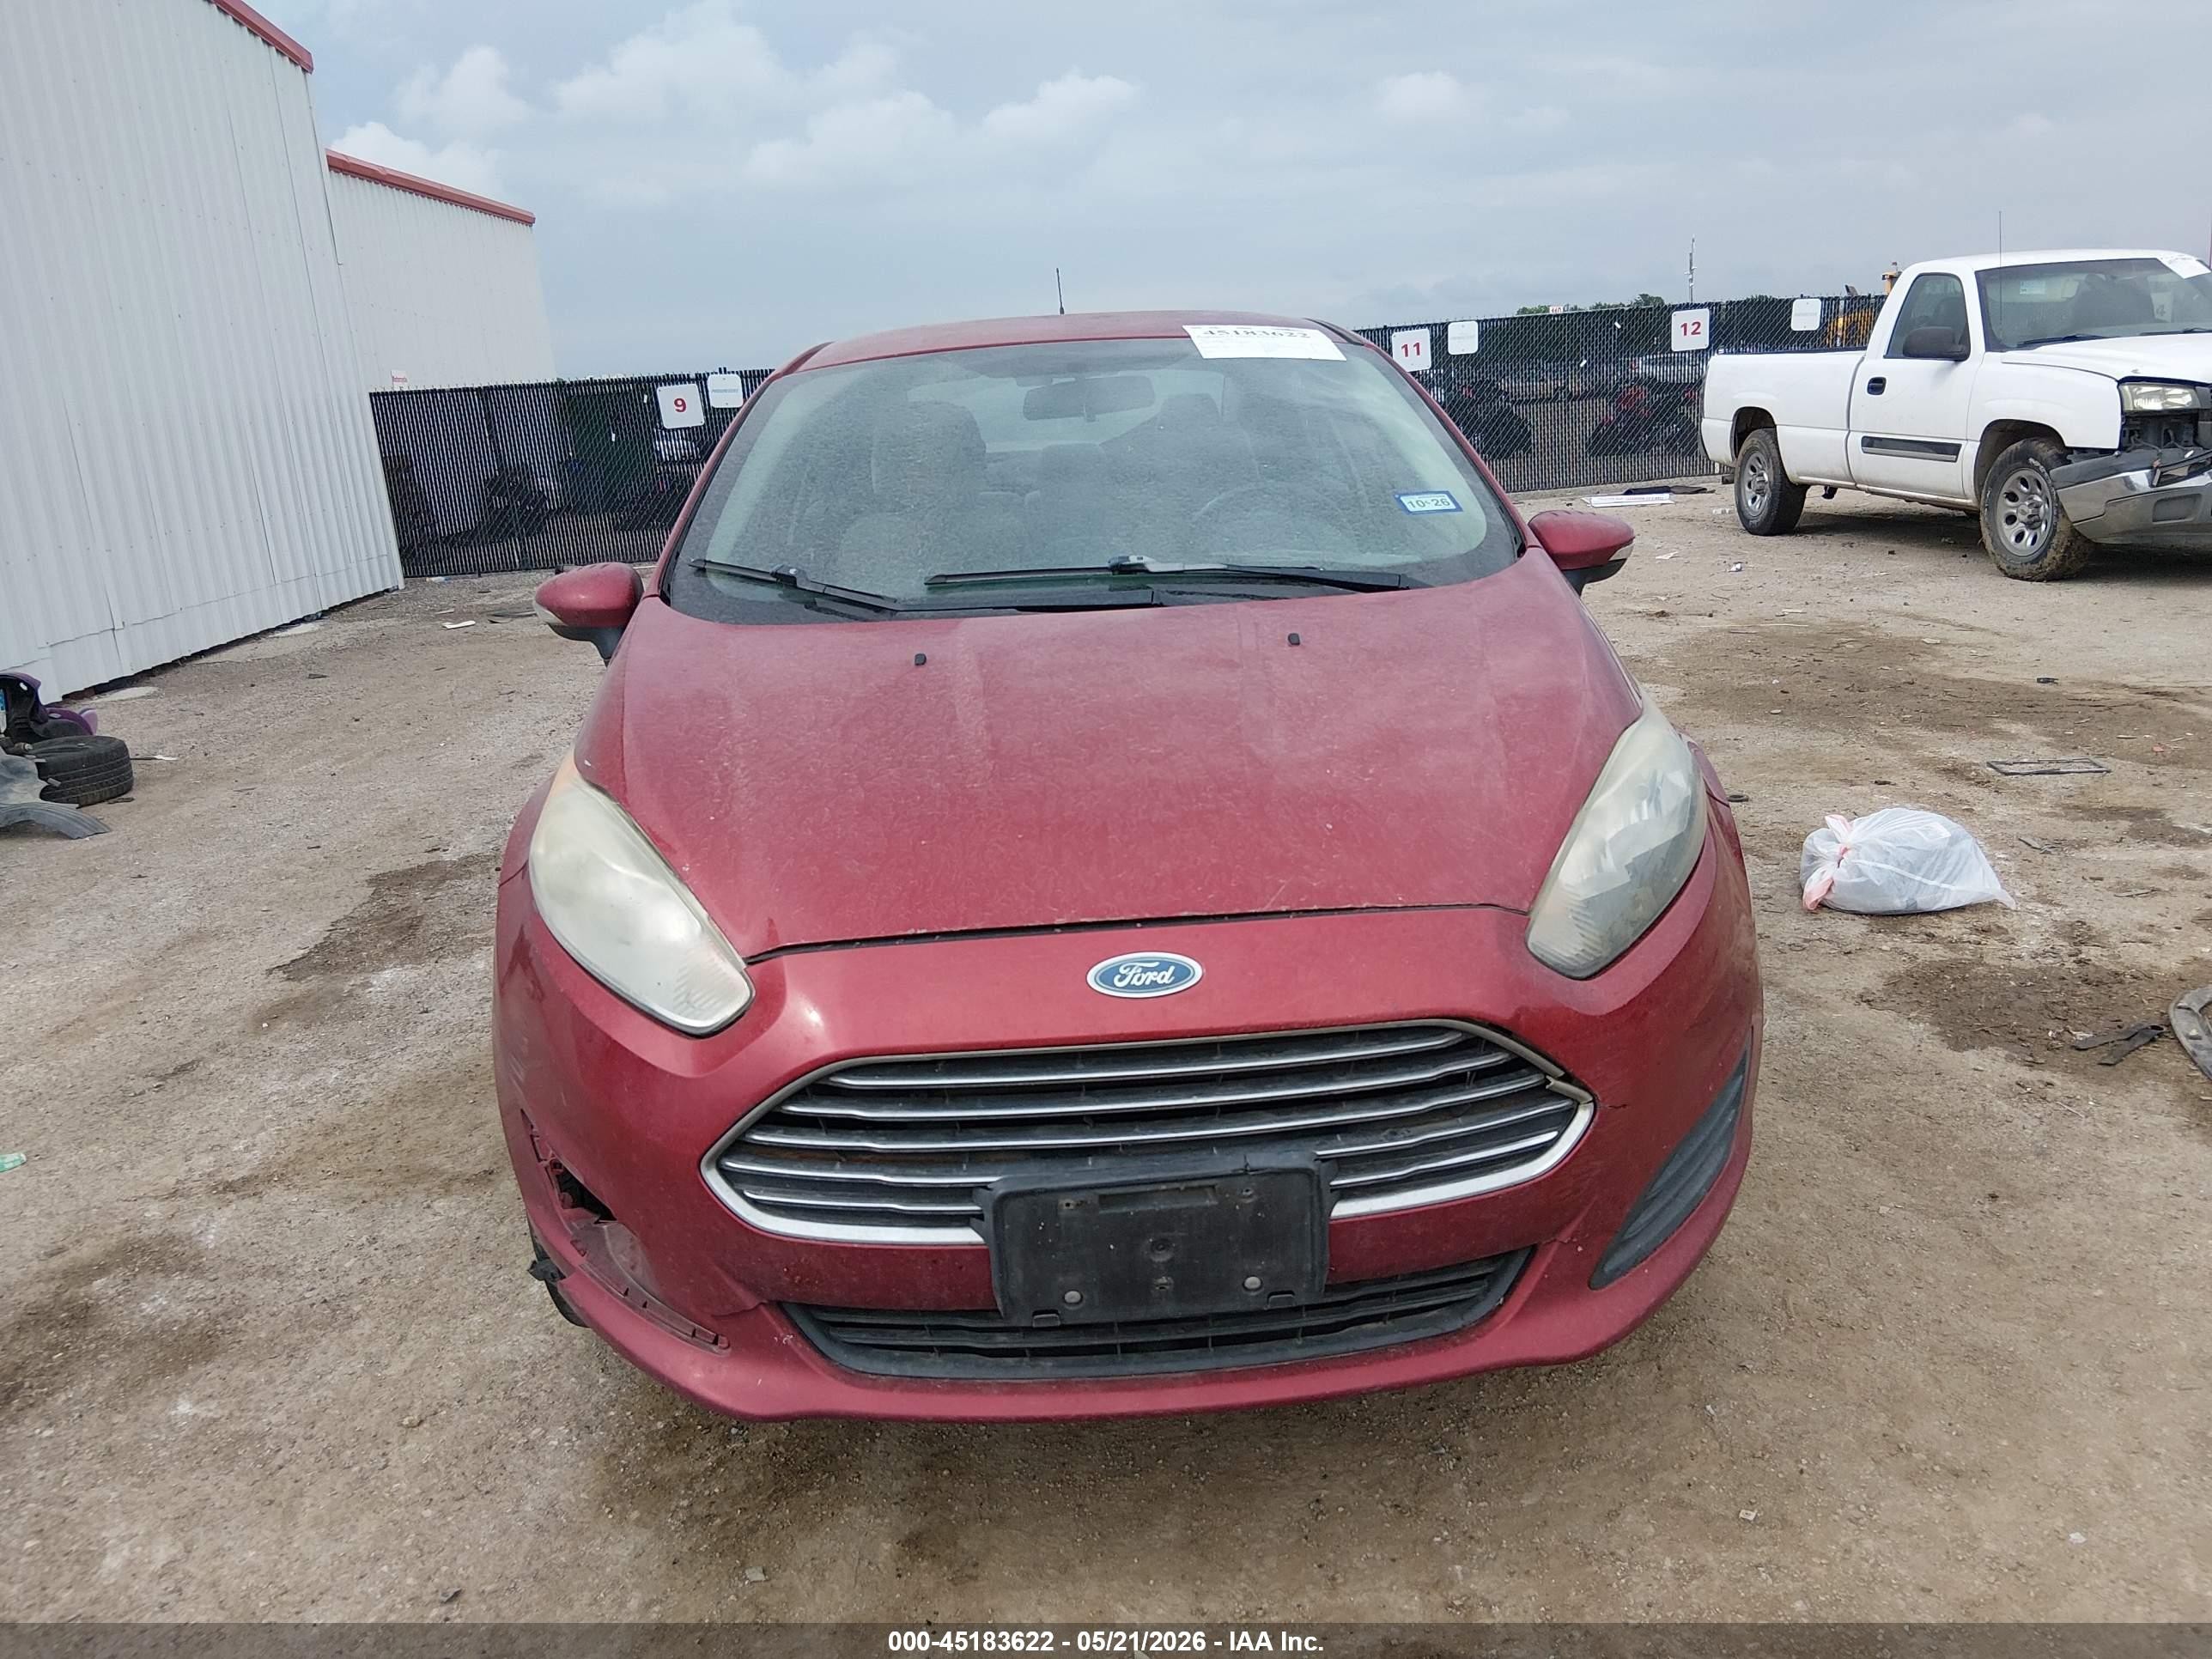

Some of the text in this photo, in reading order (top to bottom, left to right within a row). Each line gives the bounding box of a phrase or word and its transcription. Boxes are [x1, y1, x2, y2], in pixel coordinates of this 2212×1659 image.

[1680, 321, 1702, 337] 12
[1401, 343, 1421, 358] 11
[673, 398, 687, 413] 9
[1113, 961, 1176, 988] Ford
